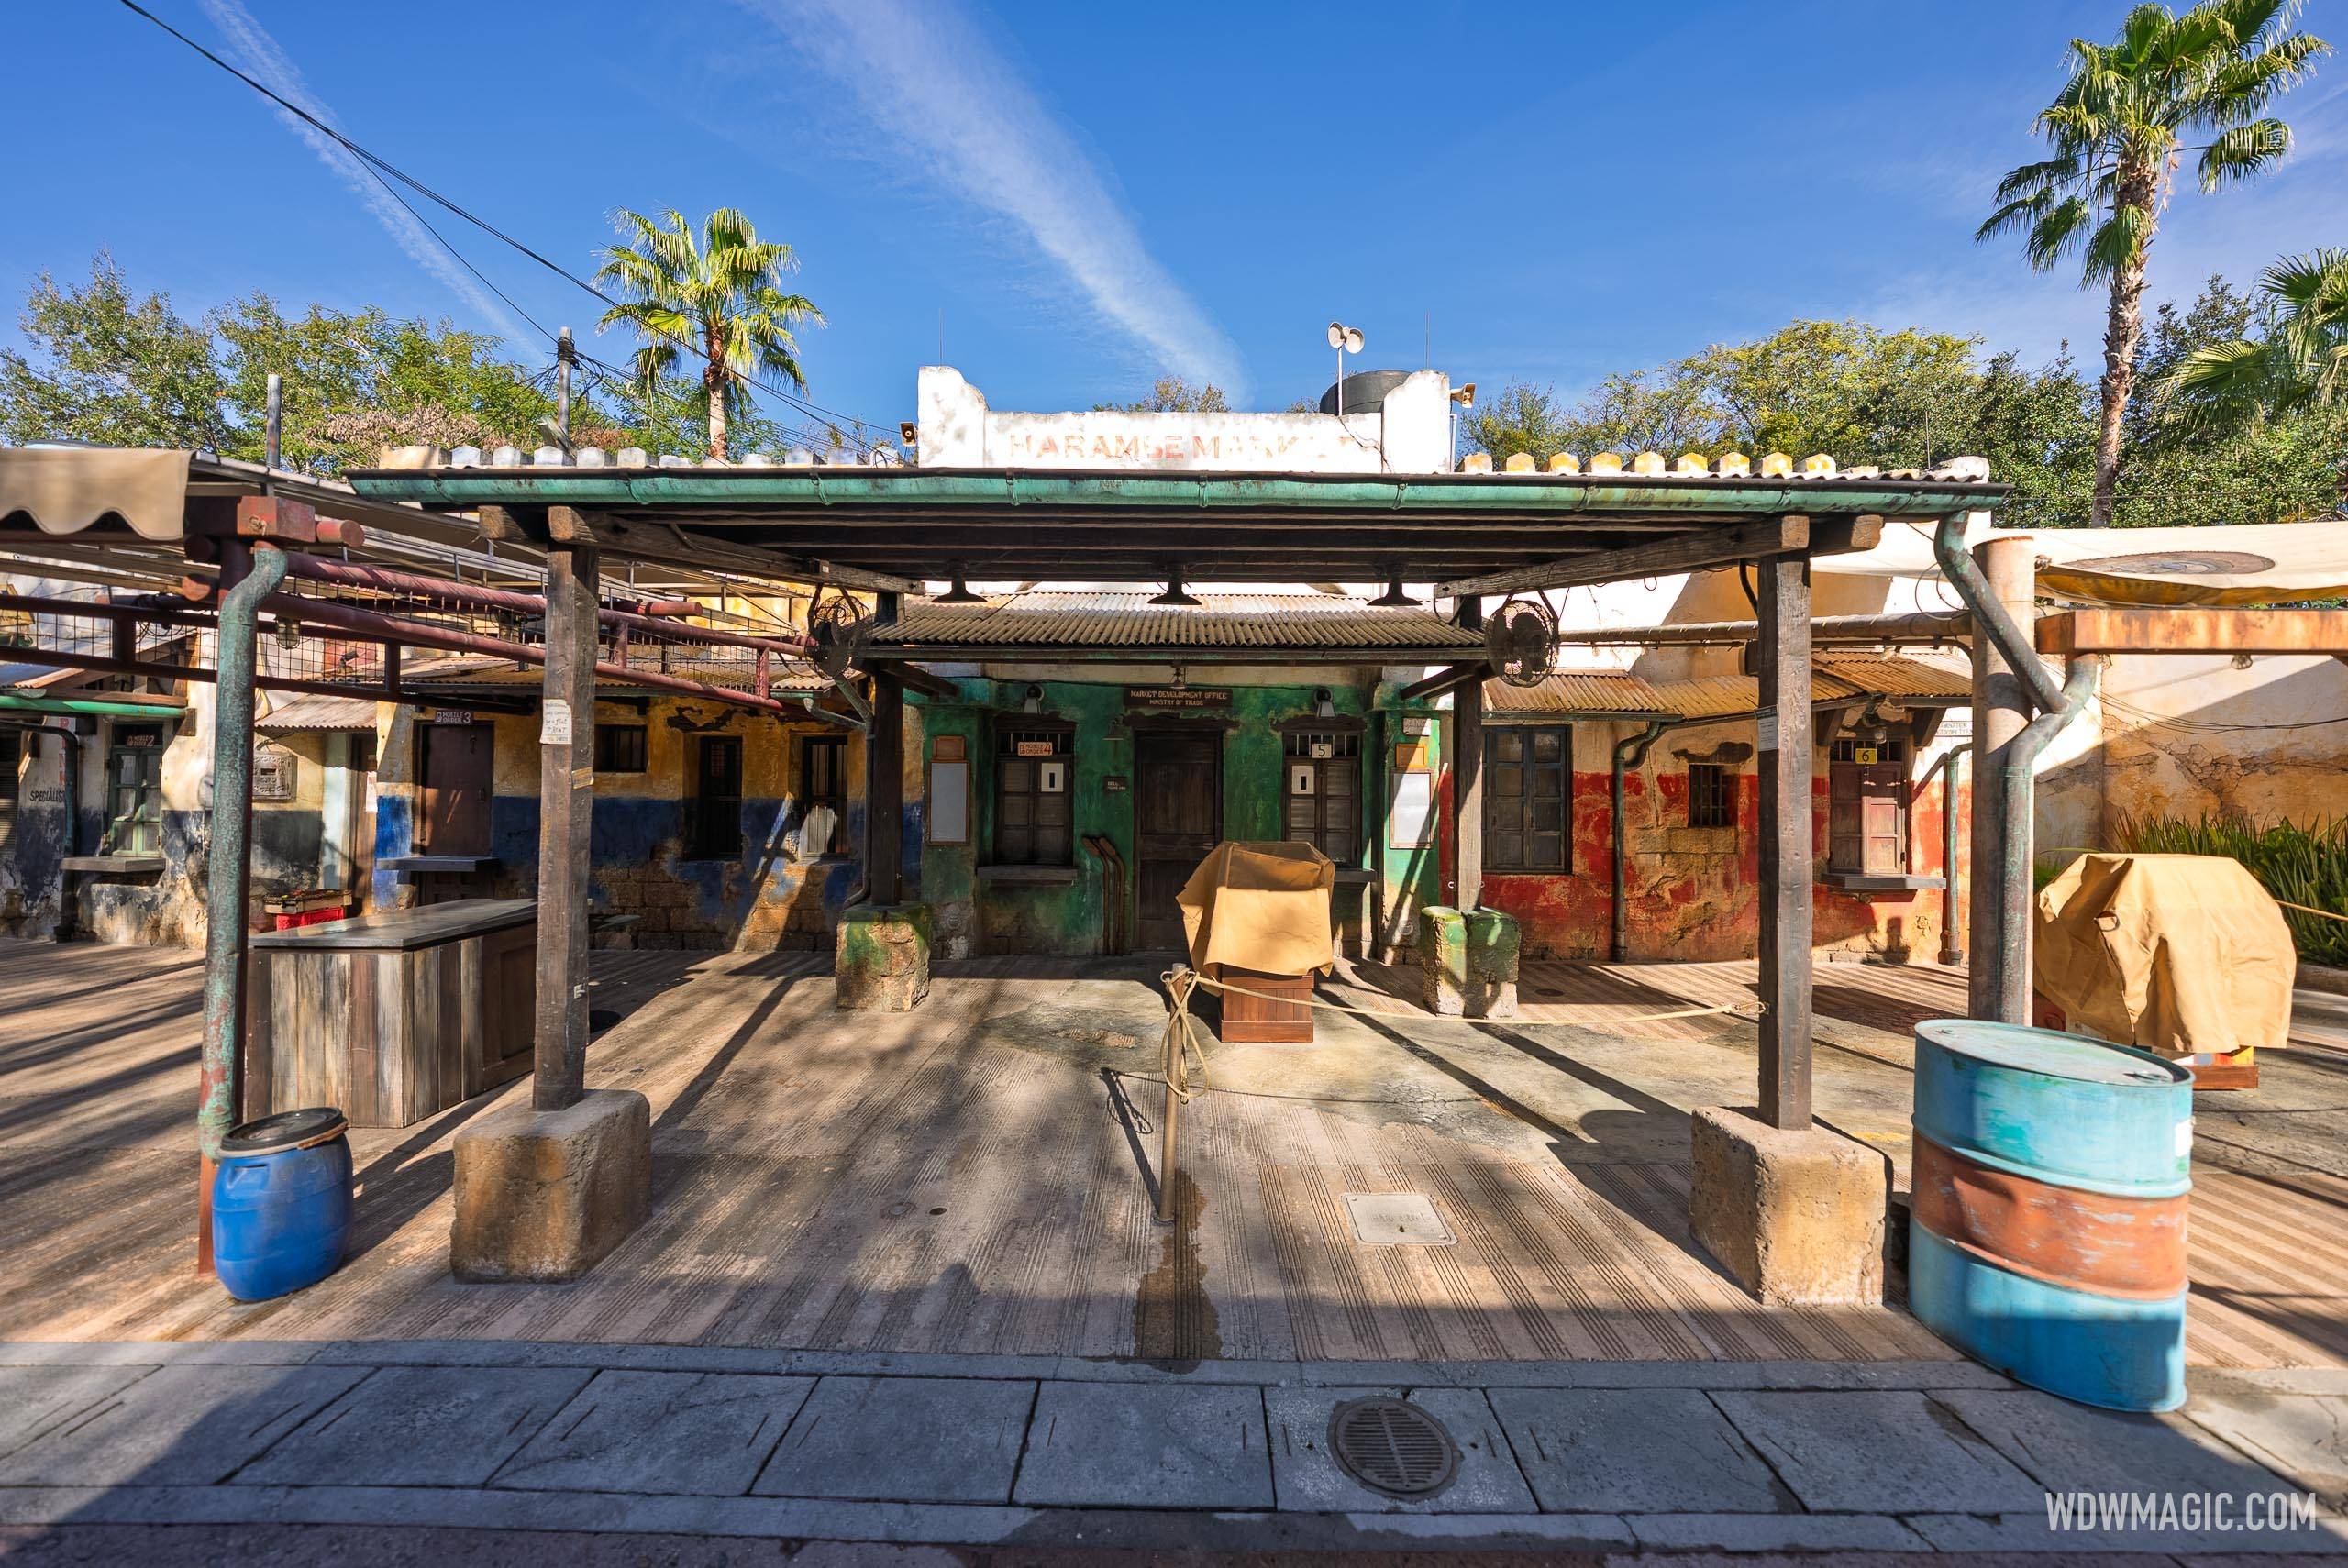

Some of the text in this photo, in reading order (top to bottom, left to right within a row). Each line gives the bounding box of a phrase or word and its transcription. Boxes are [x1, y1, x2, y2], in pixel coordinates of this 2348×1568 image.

[1193, 435, 1356, 459] MARKT
[1157, 690, 1202, 699] DEVELOPMENT
[1204, 691, 1227, 700] OFFICE
[463, 712, 471, 723] 3
[147, 734, 155, 747] 2
[1043, 743, 1051, 755] 4
[1318, 745, 1326, 756] 5
[1862, 749, 1870, 762] 6
